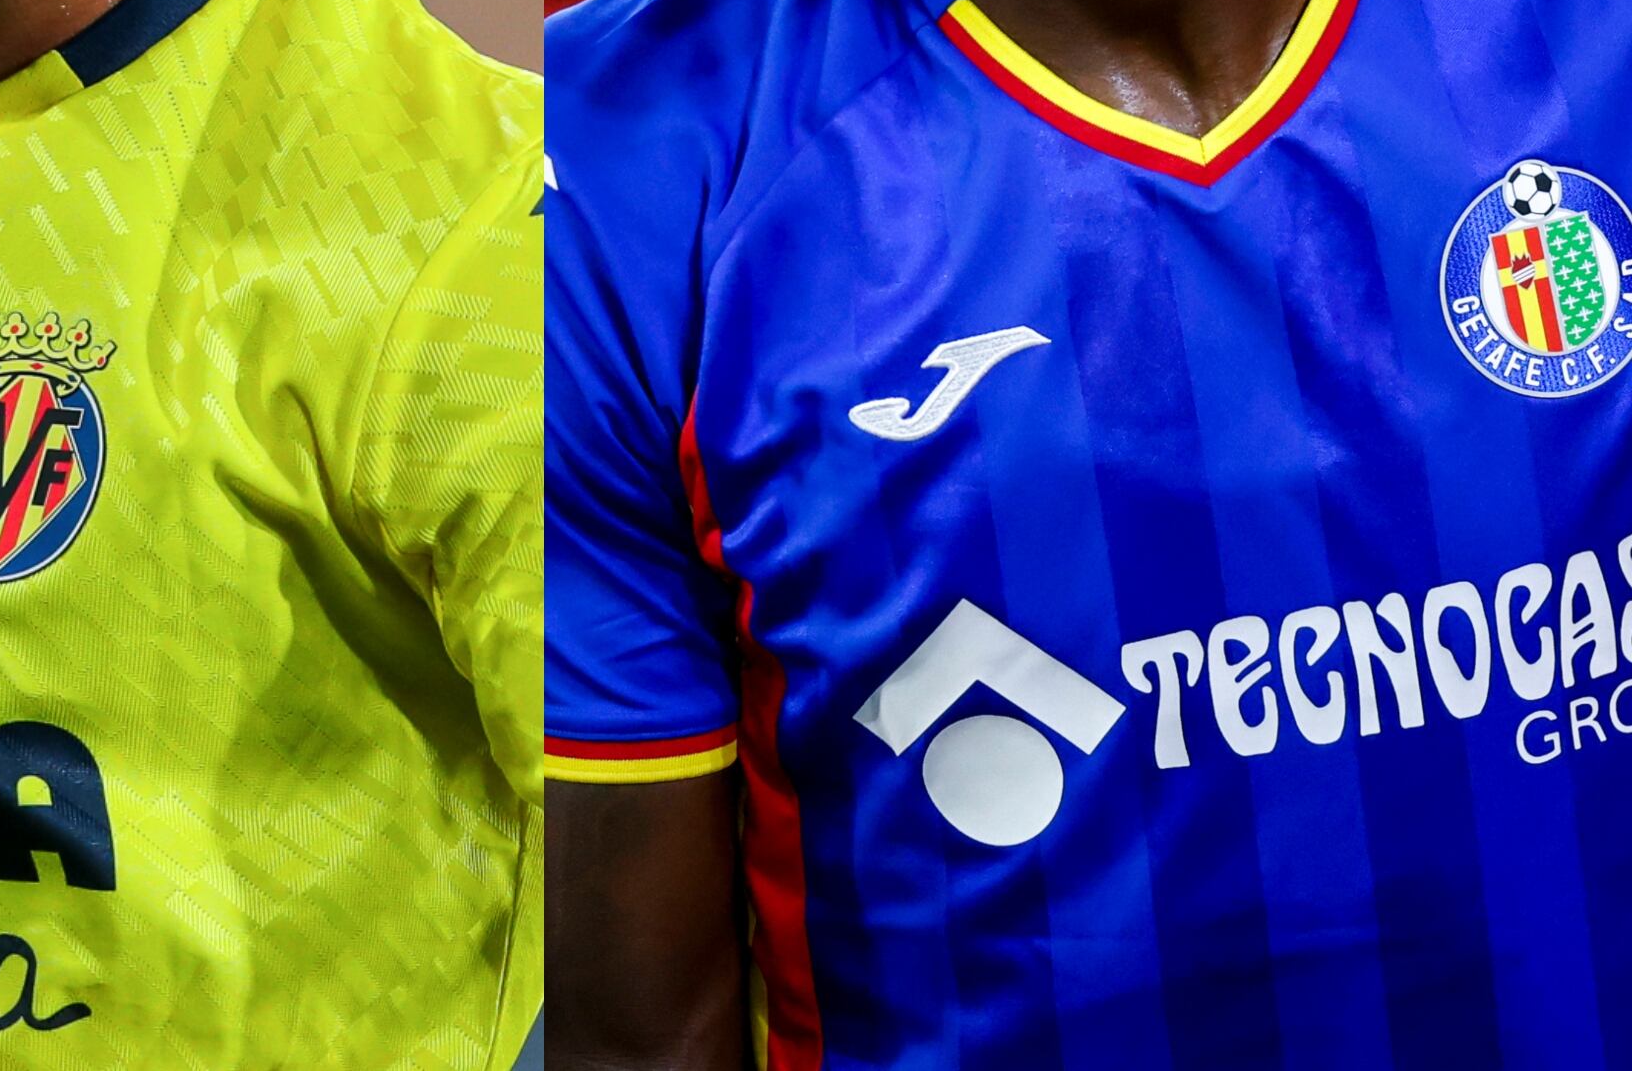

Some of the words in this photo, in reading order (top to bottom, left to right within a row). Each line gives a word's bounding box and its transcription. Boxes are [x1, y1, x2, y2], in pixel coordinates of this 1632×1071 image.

[1453, 295, 1544, 387] GETAFE
[1561, 344, 1616, 386] C.F.
[1121, 533, 1632, 770] TECNOCA
